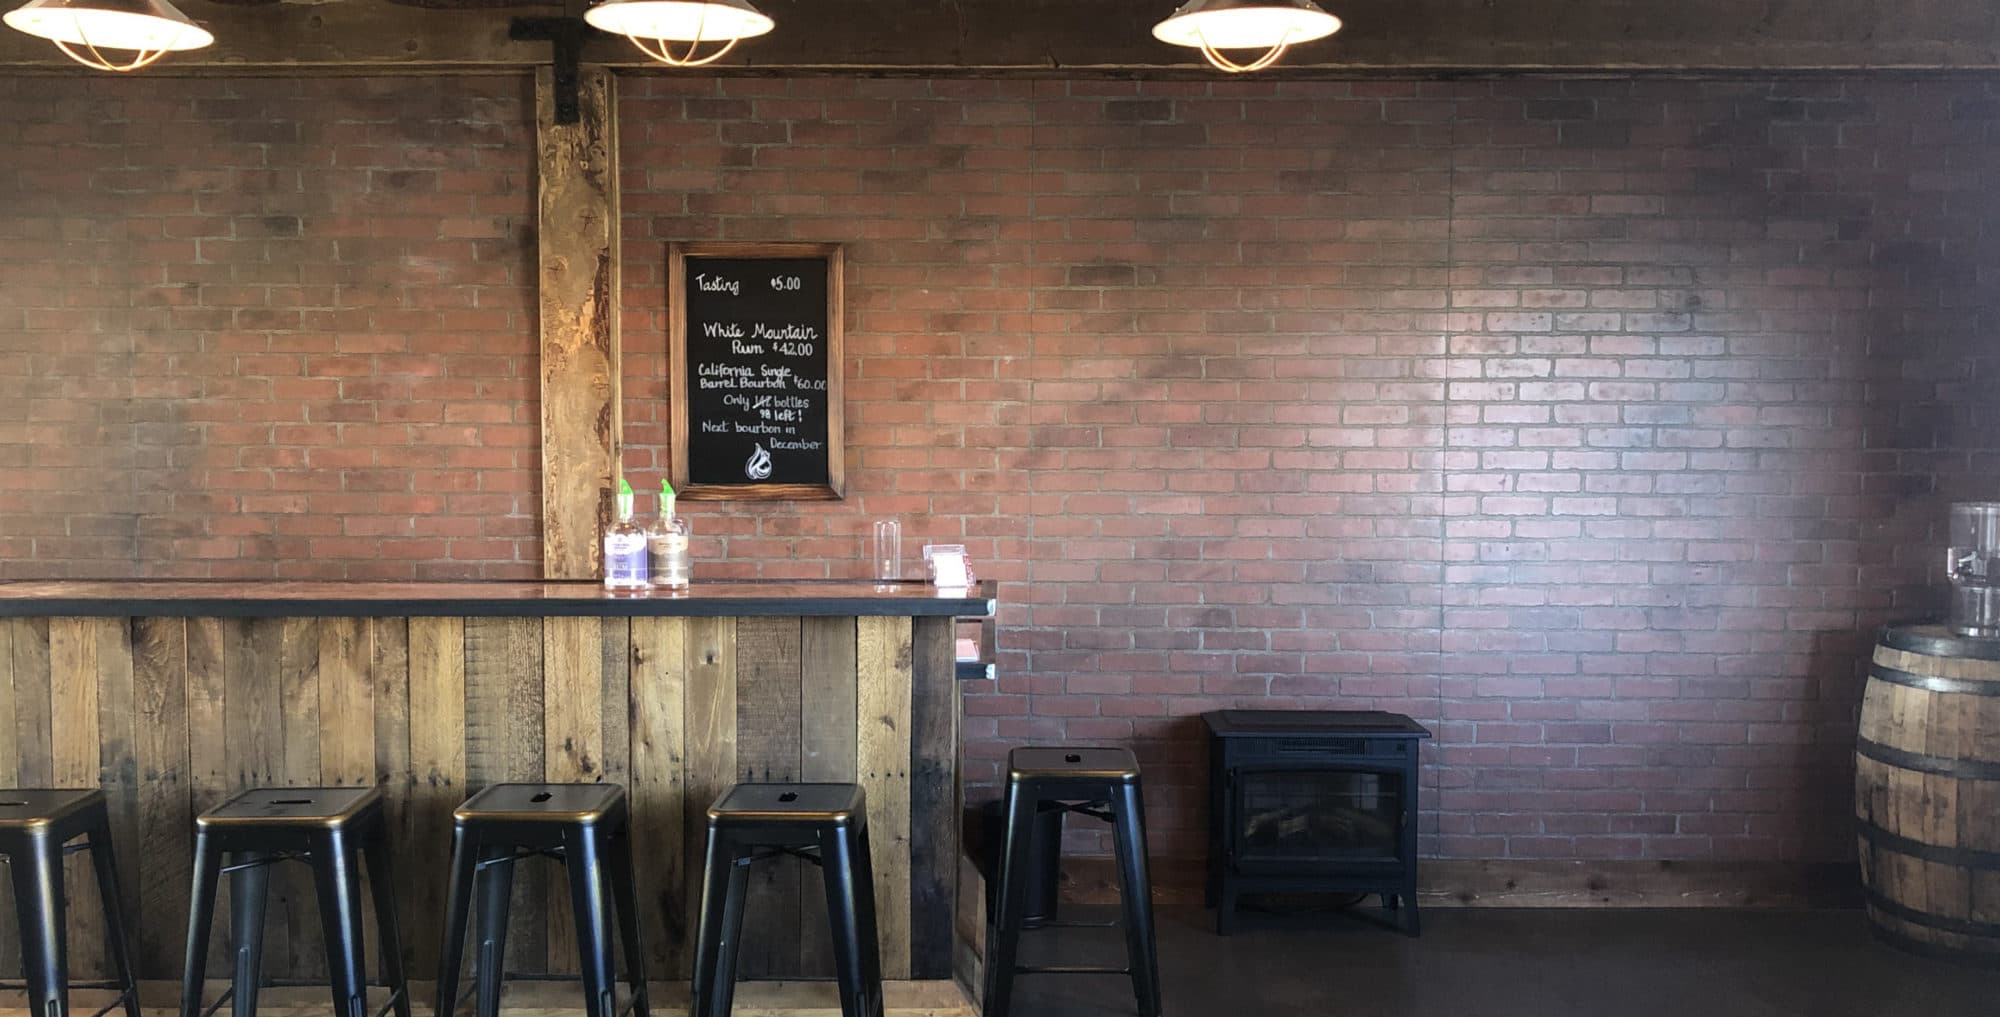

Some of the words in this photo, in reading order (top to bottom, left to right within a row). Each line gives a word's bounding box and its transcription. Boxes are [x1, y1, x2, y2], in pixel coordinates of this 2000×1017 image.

[695, 272, 740, 296] Tasting
[703, 321, 745, 338] White
[751, 322, 818, 340] Mountain
[732, 340, 765, 355] Rum
[772, 342, 813, 357] $42.00
[698, 362, 755, 378] California
[760, 363, 793, 380] Single
[700, 378, 738, 390] Barrel
[739, 377, 786, 389] Bourbon
[723, 393, 750, 412] Only
[774, 395, 810, 409] bottles
[702, 420, 730, 433] Next
[735, 420, 781, 434] bourbon
[785, 426, 796, 435] in
[770, 437, 821, 450] December
